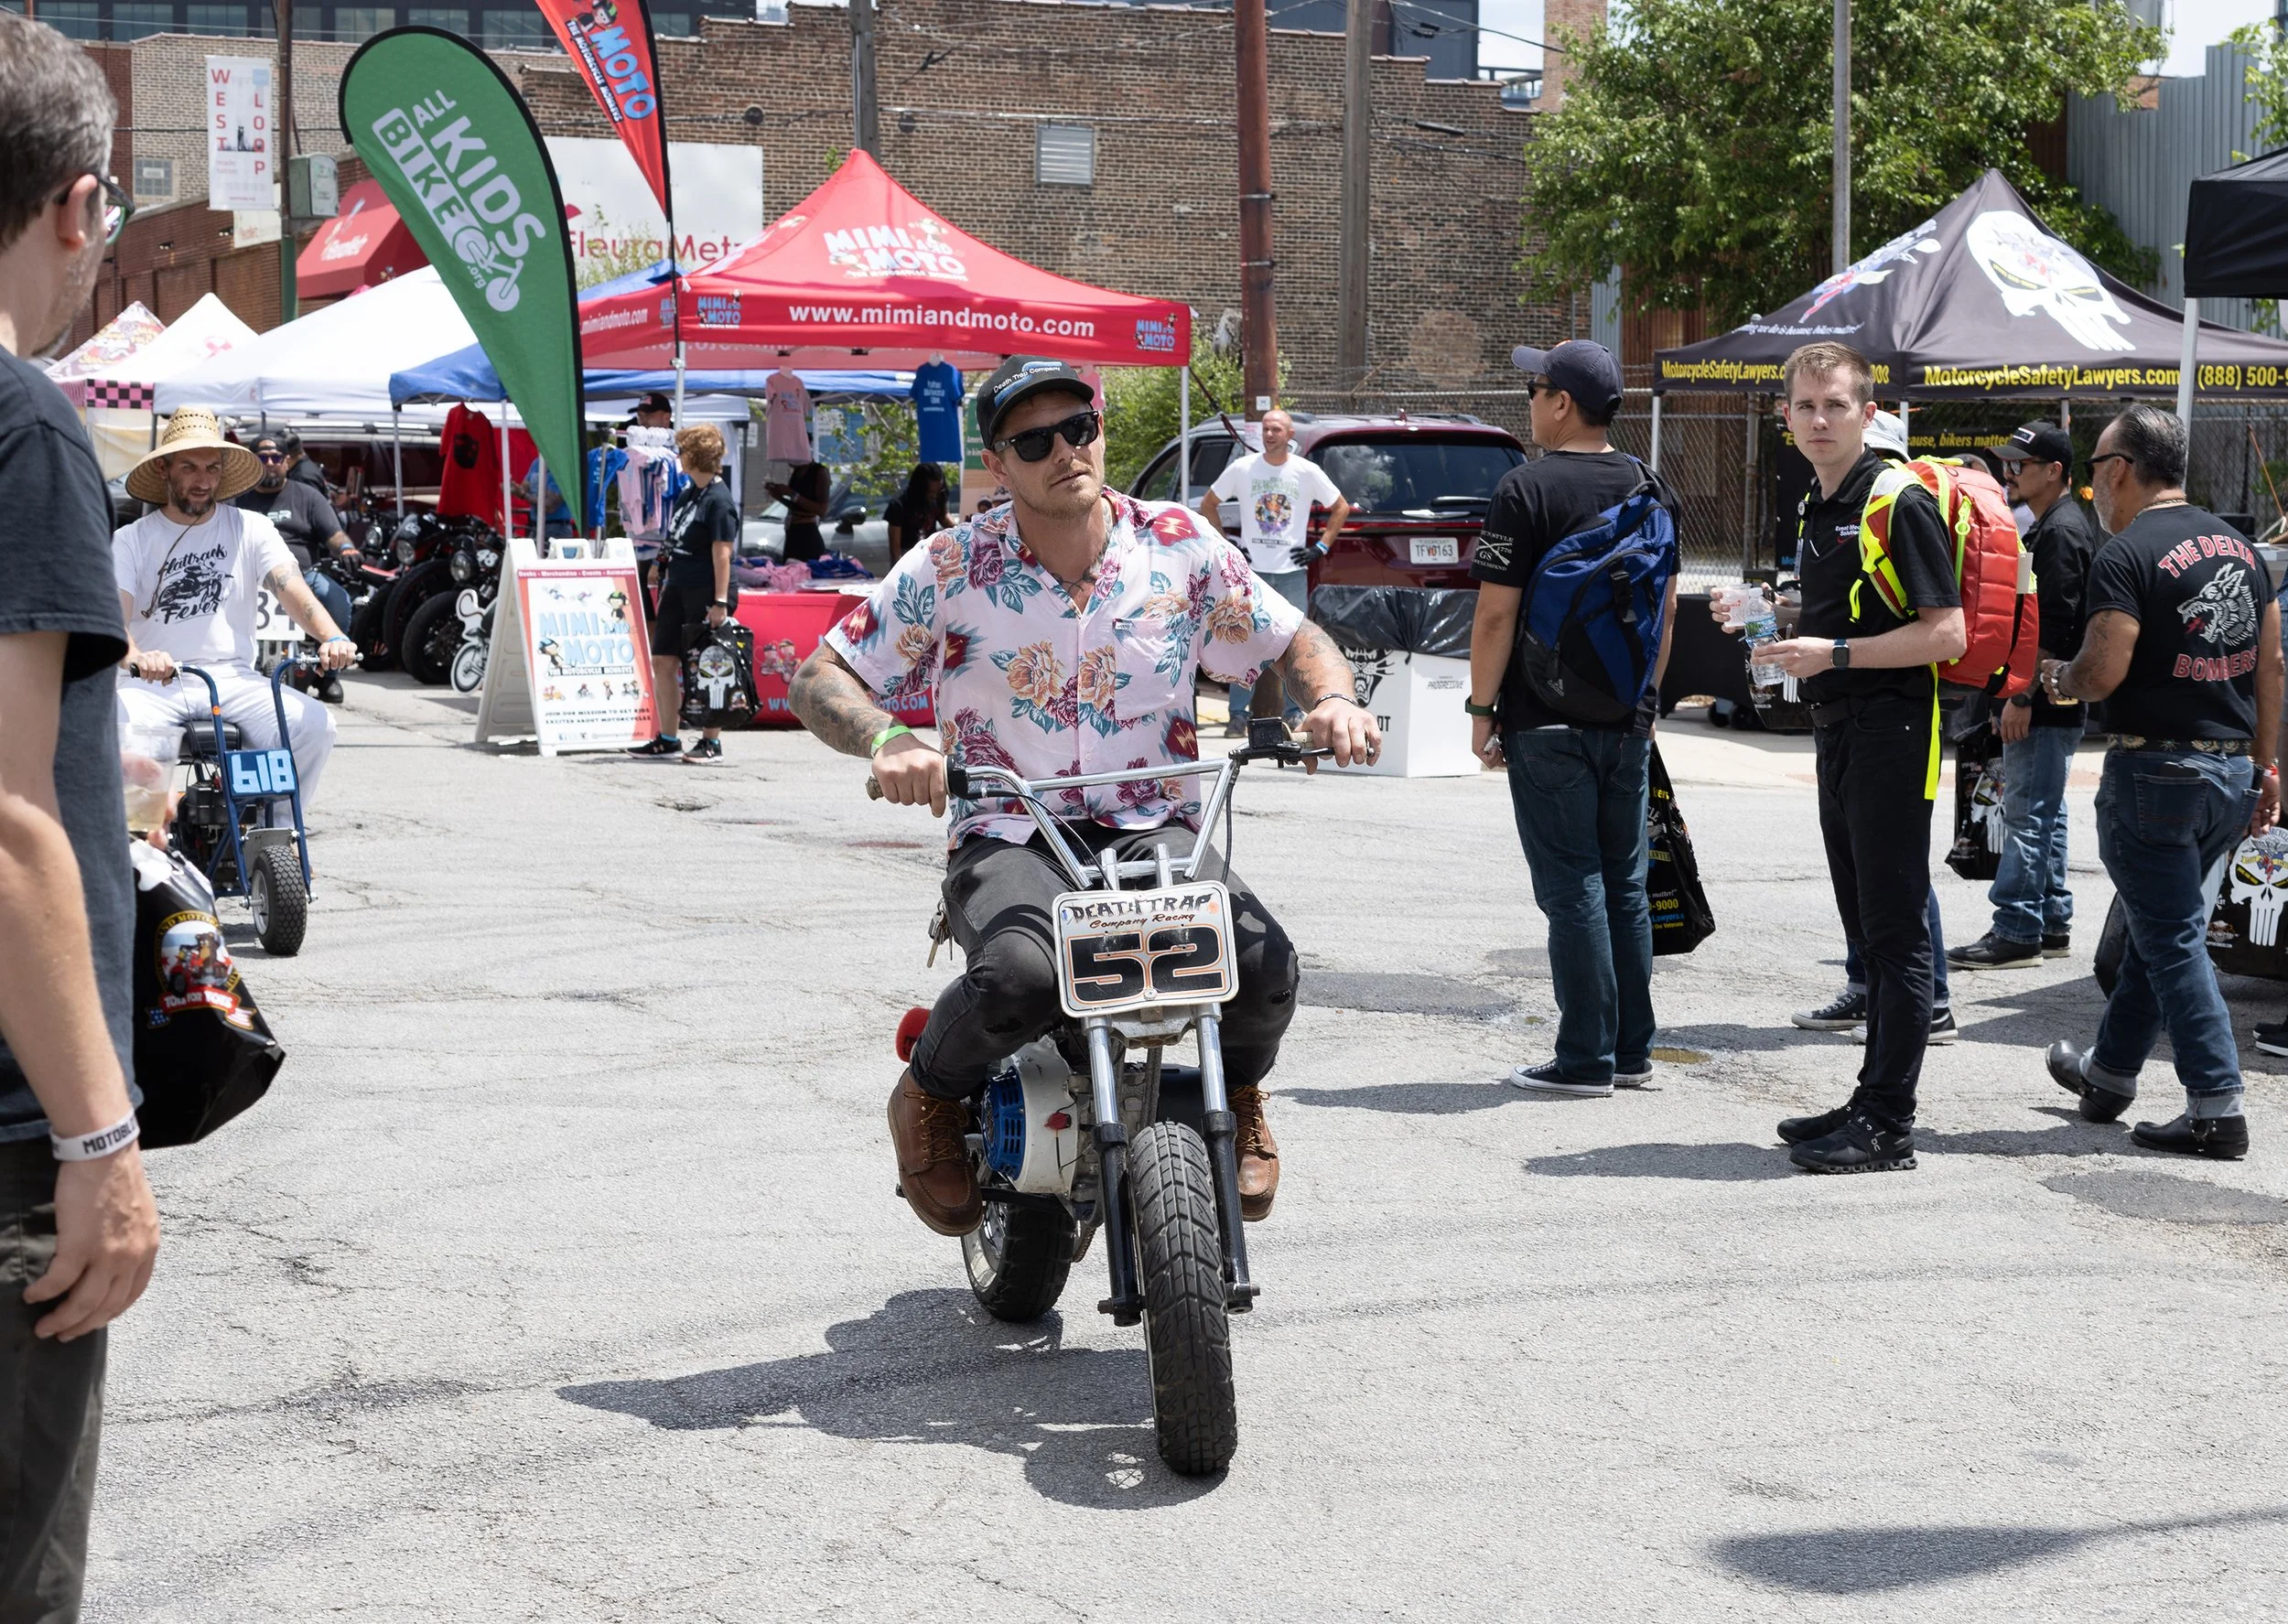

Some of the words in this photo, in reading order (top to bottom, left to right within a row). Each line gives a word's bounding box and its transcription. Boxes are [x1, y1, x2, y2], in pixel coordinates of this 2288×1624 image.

[588, 26, 656, 119] MOTO
[210, 69, 231, 152] WEST
[413, 90, 457, 128] ALL
[253, 92, 265, 175] LOOP
[377, 115, 465, 227] BIKE
[430, 115, 545, 258] KIDS
[823, 225, 913, 253] MIMI
[863, 248, 966, 274] MOTO
[697, 296, 727, 310] MIMI
[707, 311, 741, 324] MOTO
[789, 304, 1095, 338] www.mimiandmoto.com
[1136, 319, 1162, 333] MIMI
[1144, 333, 1175, 348] MOTO
[993, 377, 1012, 393] Death
[1662, 360, 1786, 384] MotorcycleSafetyLawyers.c
[1925, 364, 2180, 391] MotorcycleSafetyLawyers.com
[2198, 364, 2241, 391] (888)
[1939, 432, 1971, 446] bikers
[2157, 539, 2203, 578] THE
[2196, 534, 2257, 571] DELTA
[160, 598, 219, 624] Fever
[539, 611, 599, 637] MIMI
[563, 639, 635, 665] MOTO
[1089, 918, 1148, 930] Company
[1151, 914, 1195, 923] Racing
[1067, 924, 1226, 1006] 52
